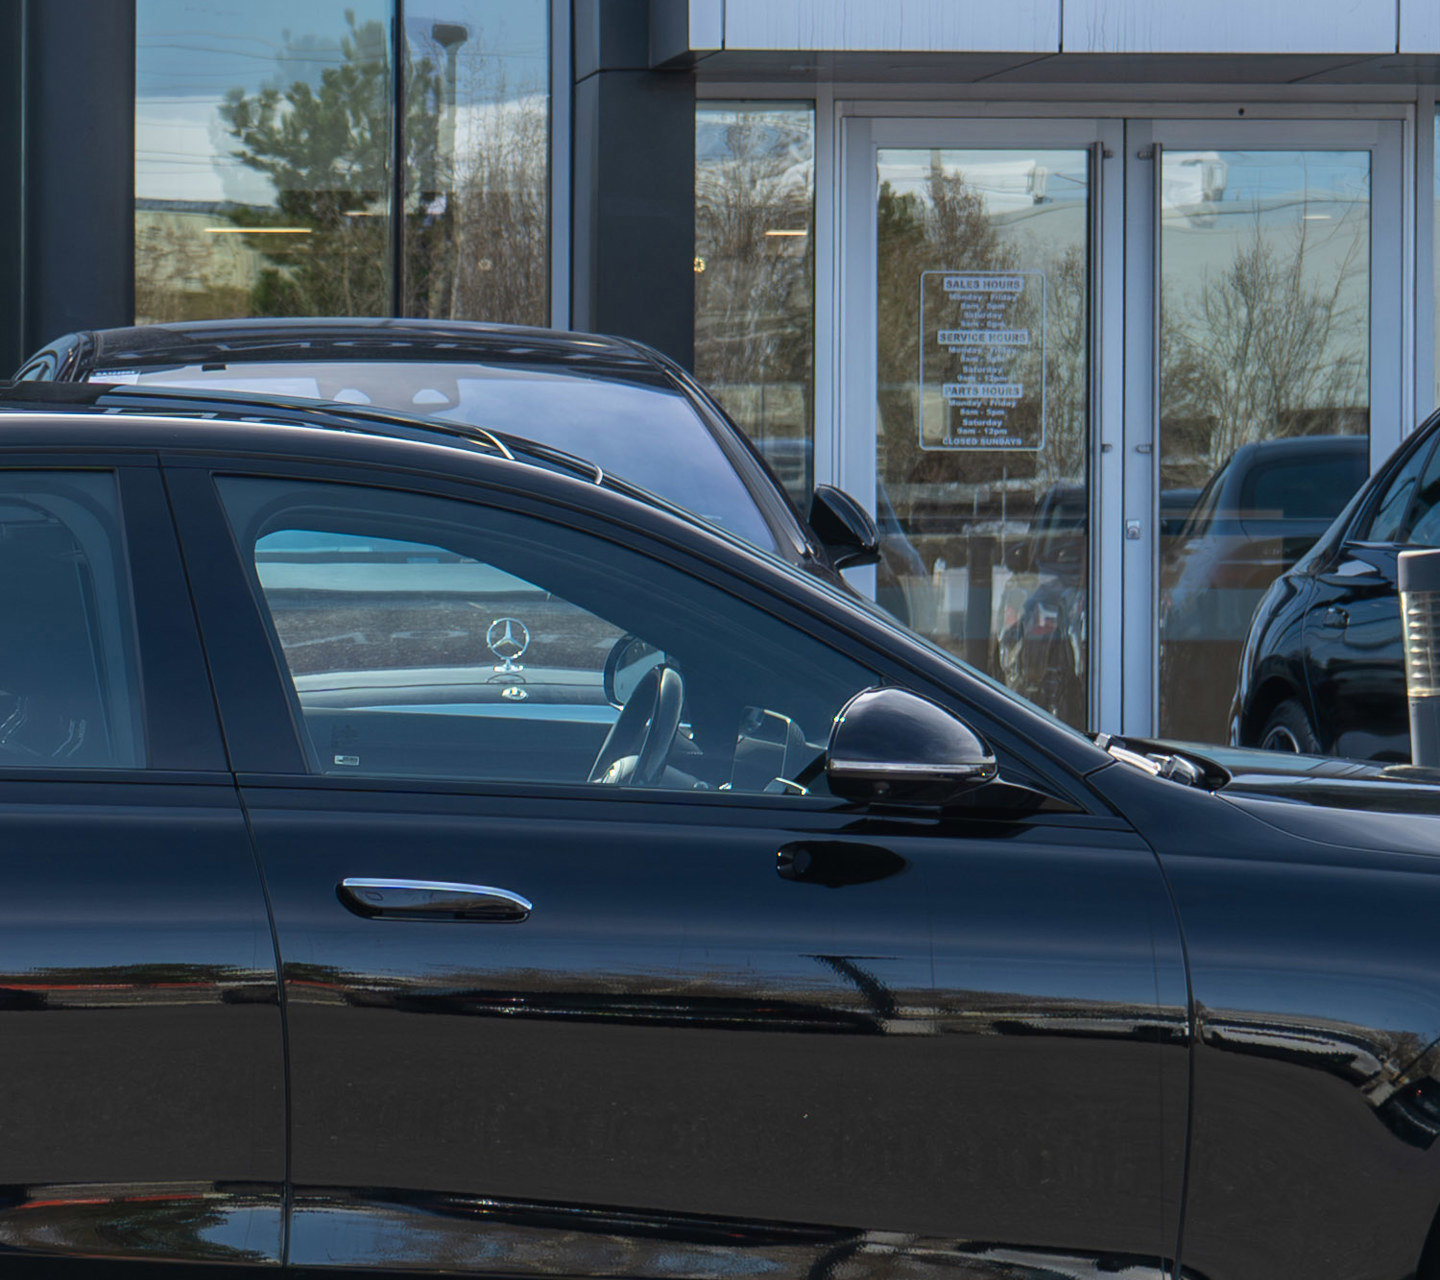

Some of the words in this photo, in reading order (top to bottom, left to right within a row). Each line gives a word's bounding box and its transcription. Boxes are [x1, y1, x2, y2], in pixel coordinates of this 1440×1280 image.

[946, 280, 979, 289] SALES
[983, 279, 1020, 289] HOURS
[940, 333, 985, 342] SERVICE
[989, 333, 1026, 342] HOURS
[963, 365, 1002, 374] Saturday
[945, 387, 979, 396] PARTS
[982, 387, 1020, 396] HOURS
[949, 399, 982, 408] Monday
[990, 399, 1017, 408] Friday
[963, 419, 1003, 428] Saturday
[984, 427, 1008, 436] 12pm
[943, 437, 978, 446] CLOSED
[980, 437, 1023, 446] SUNDAYS
